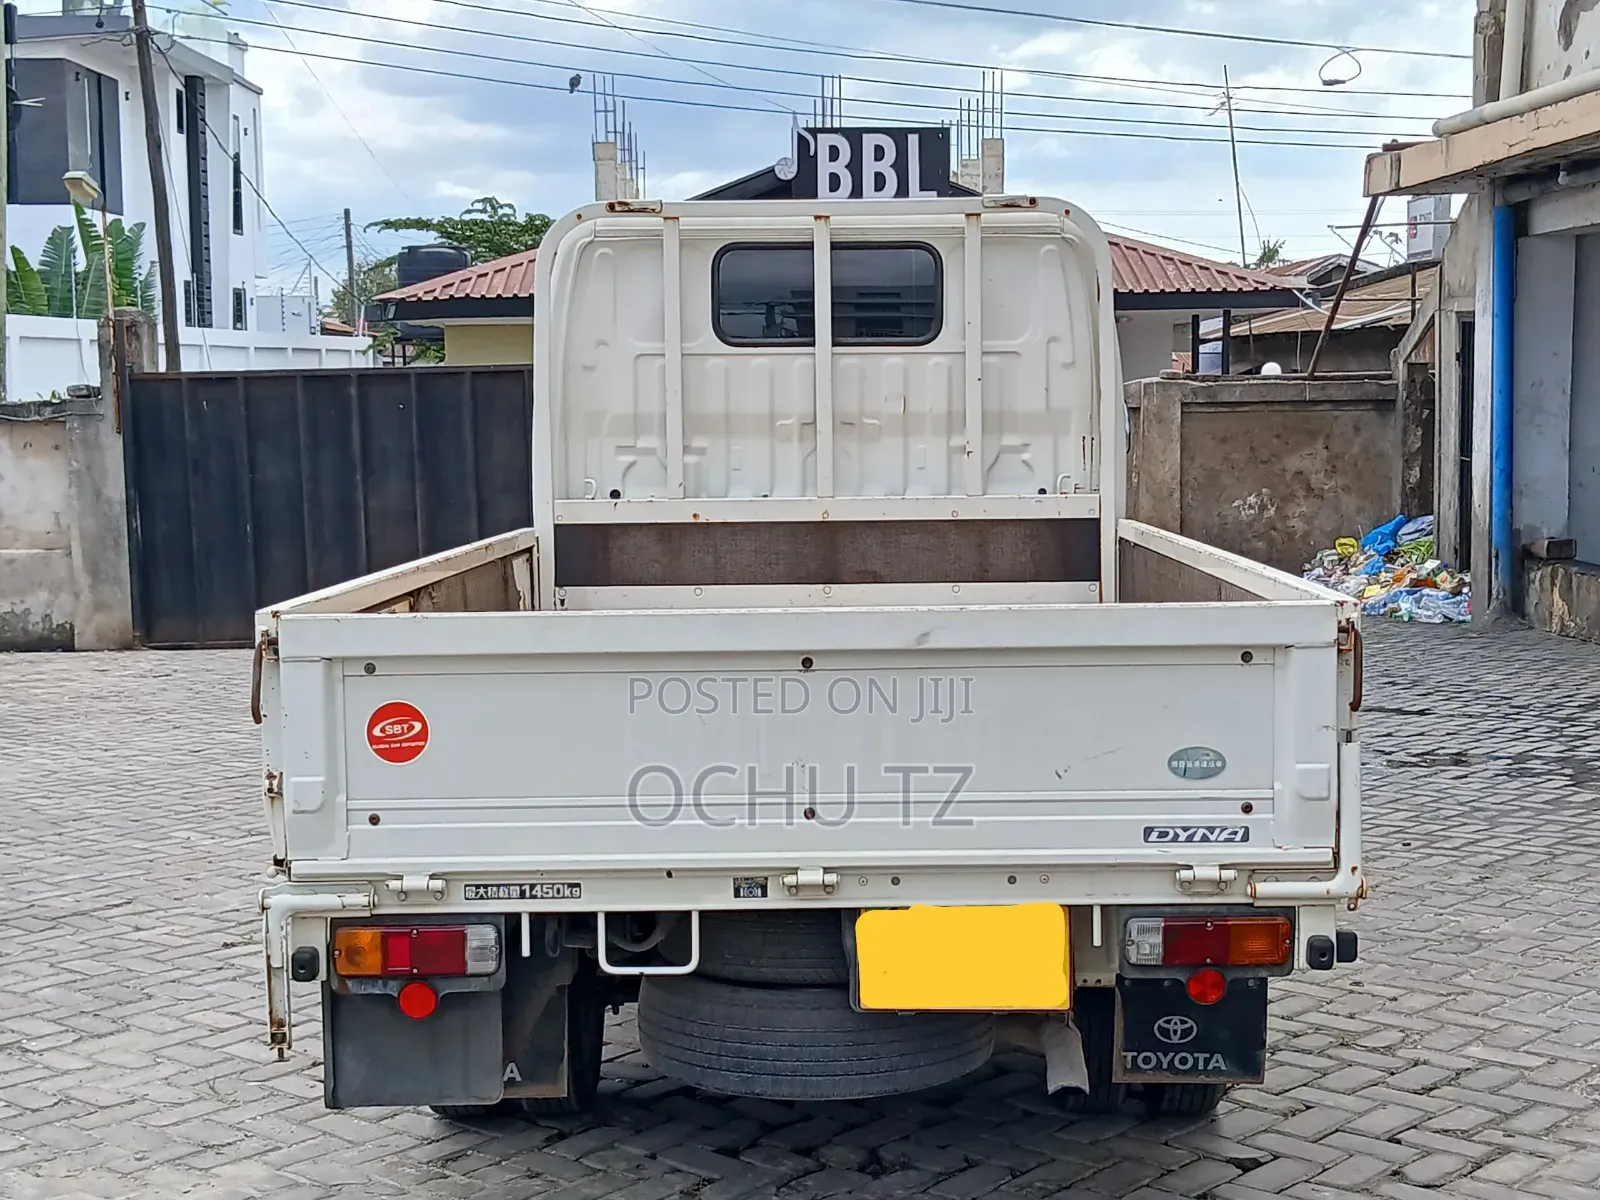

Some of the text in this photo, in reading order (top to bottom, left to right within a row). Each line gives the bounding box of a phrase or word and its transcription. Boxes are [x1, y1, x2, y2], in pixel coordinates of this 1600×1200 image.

[816, 133, 938, 199] BBL
[385, 724, 409, 735] SBT
[1147, 827, 1245, 842] DYNA
[1120, 1051, 1228, 1071] TOYOTA
